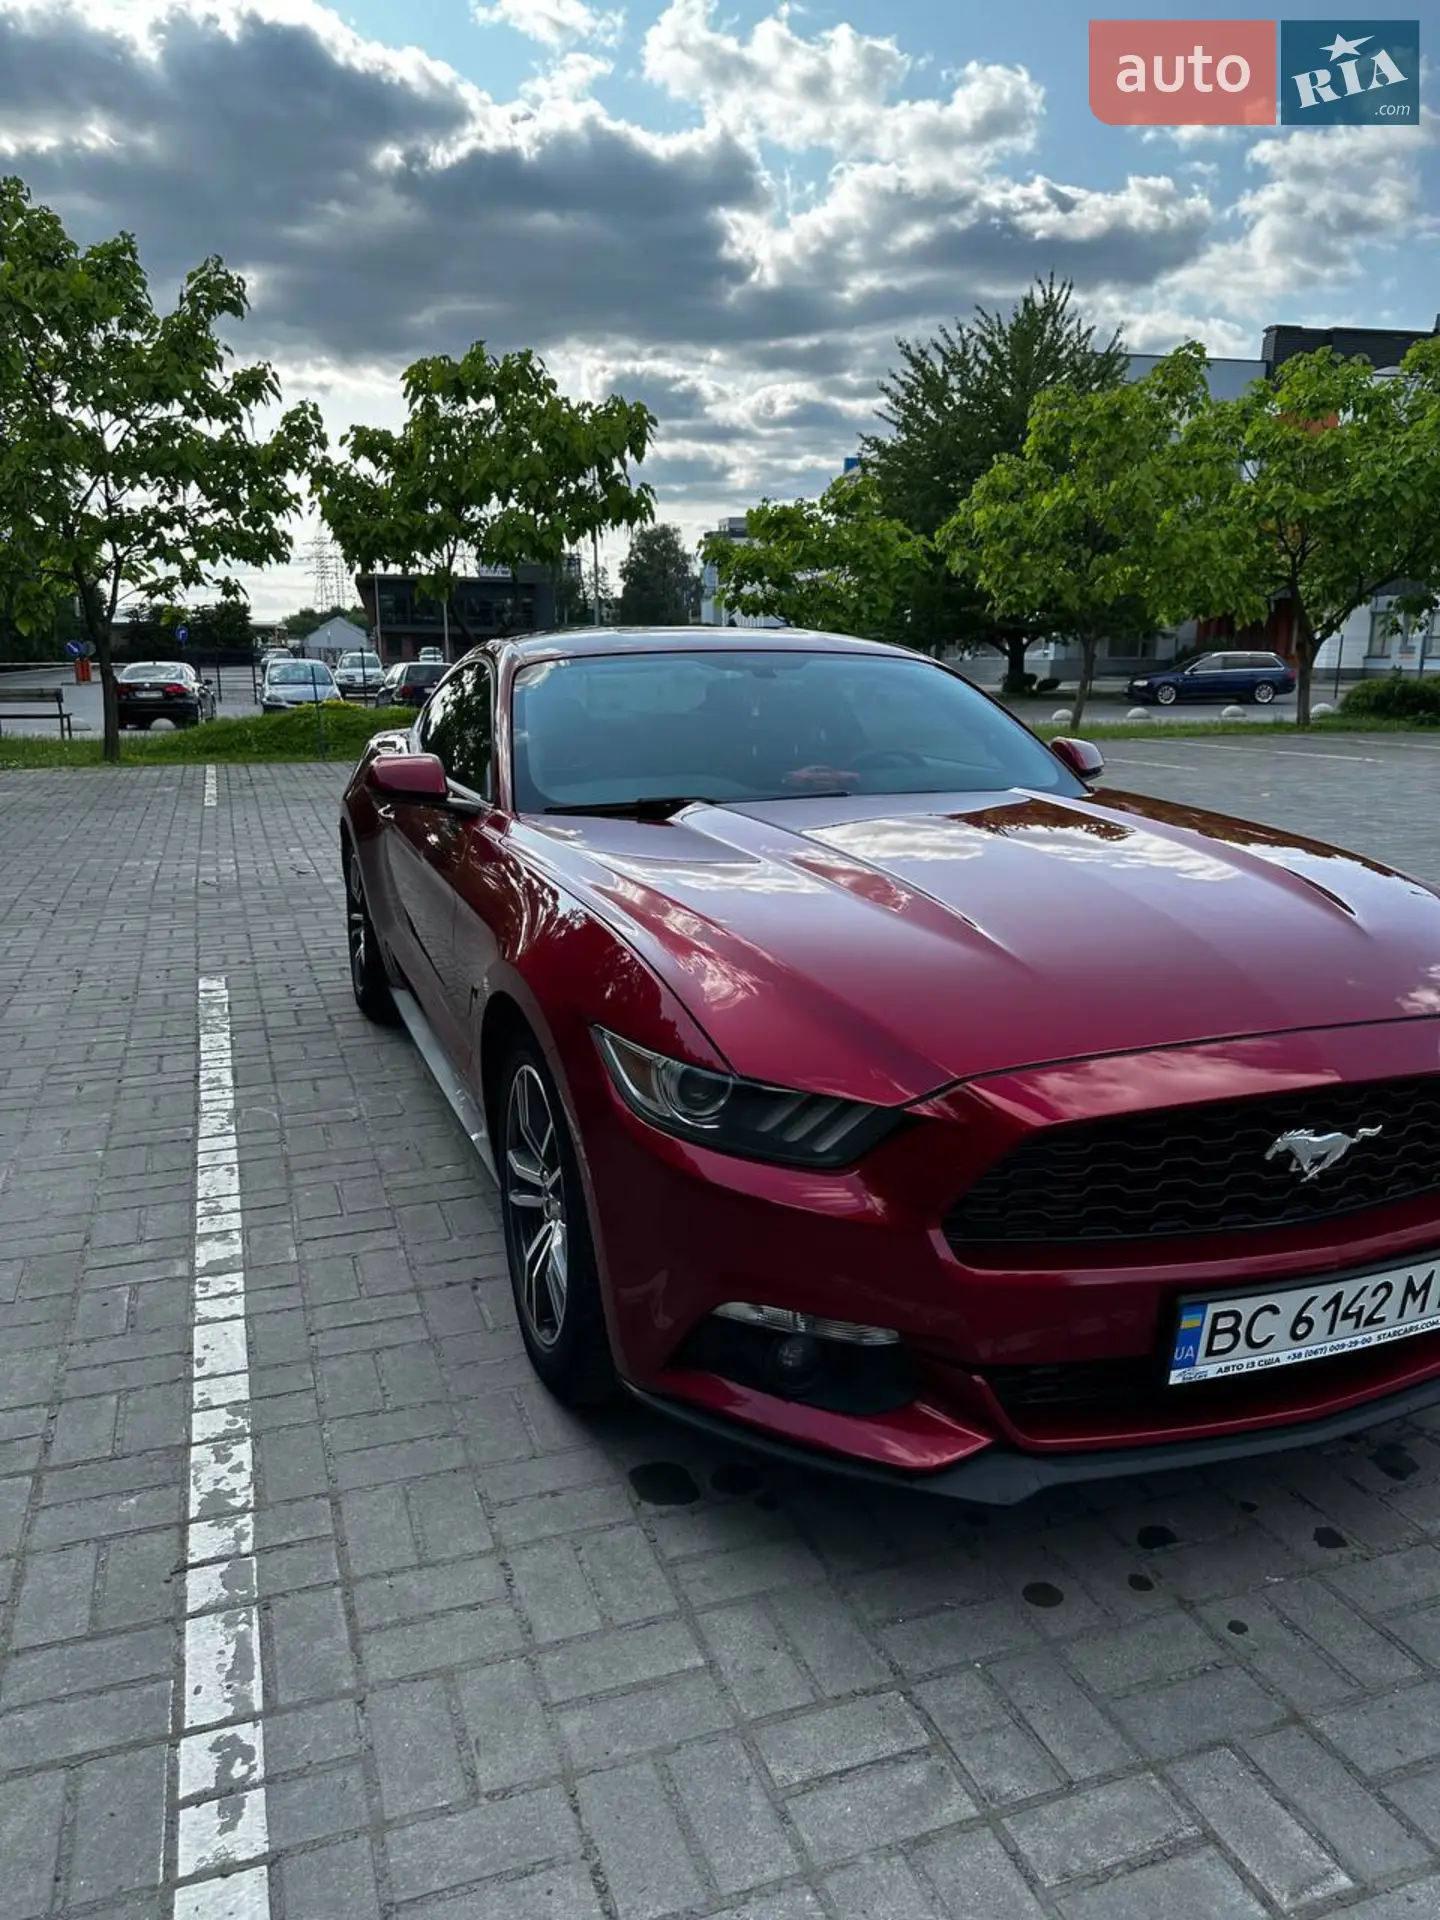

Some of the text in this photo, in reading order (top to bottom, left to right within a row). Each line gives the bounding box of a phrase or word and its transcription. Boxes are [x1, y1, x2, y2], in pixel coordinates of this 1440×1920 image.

[1204, 1268, 1440, 1358] BC 6142 M
[1174, 1345, 1195, 1361] UA
[1287, 1351, 1303, 1361] +38
